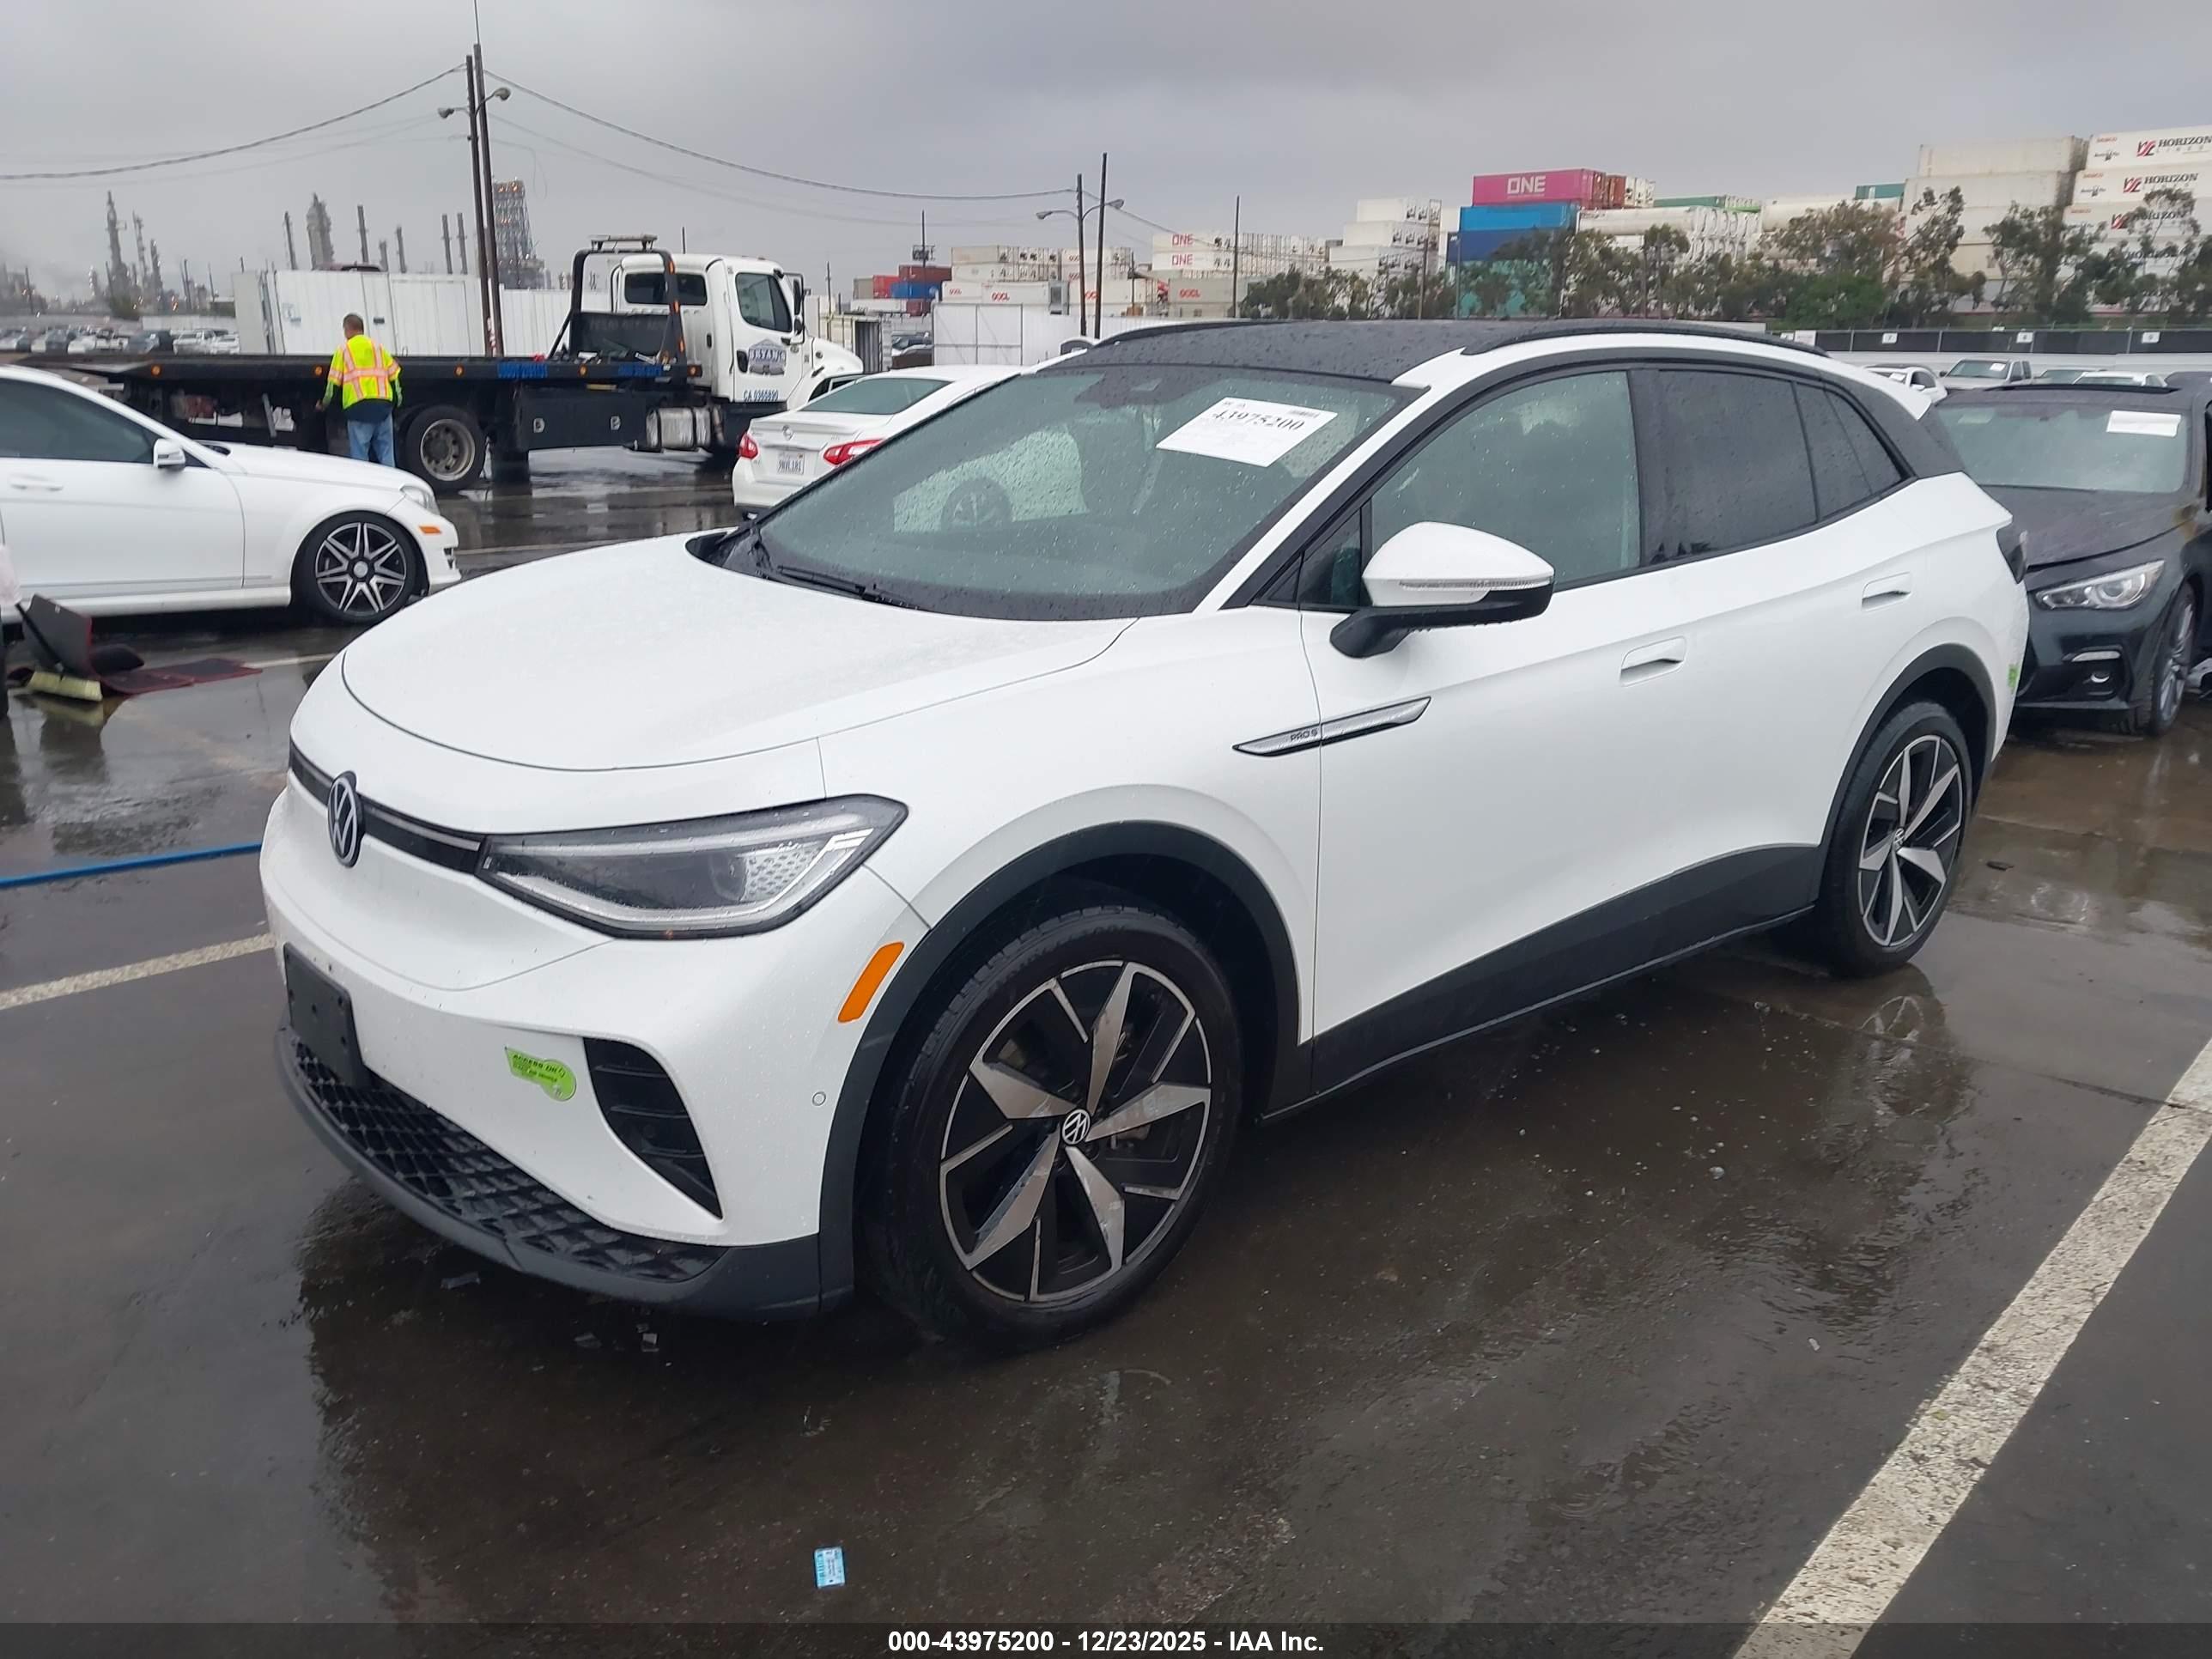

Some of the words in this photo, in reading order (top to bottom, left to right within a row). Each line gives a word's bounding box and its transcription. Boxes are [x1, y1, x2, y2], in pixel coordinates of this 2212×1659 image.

[2158, 136, 2212, 147] HORIZON
[2144, 173, 2198, 184] HORIZON
[1507, 175, 1547, 194] ONE
[1172, 234, 1194, 246] ONE
[1172, 254, 1194, 265] ONE
[1291, 731, 1310, 742] PRO
